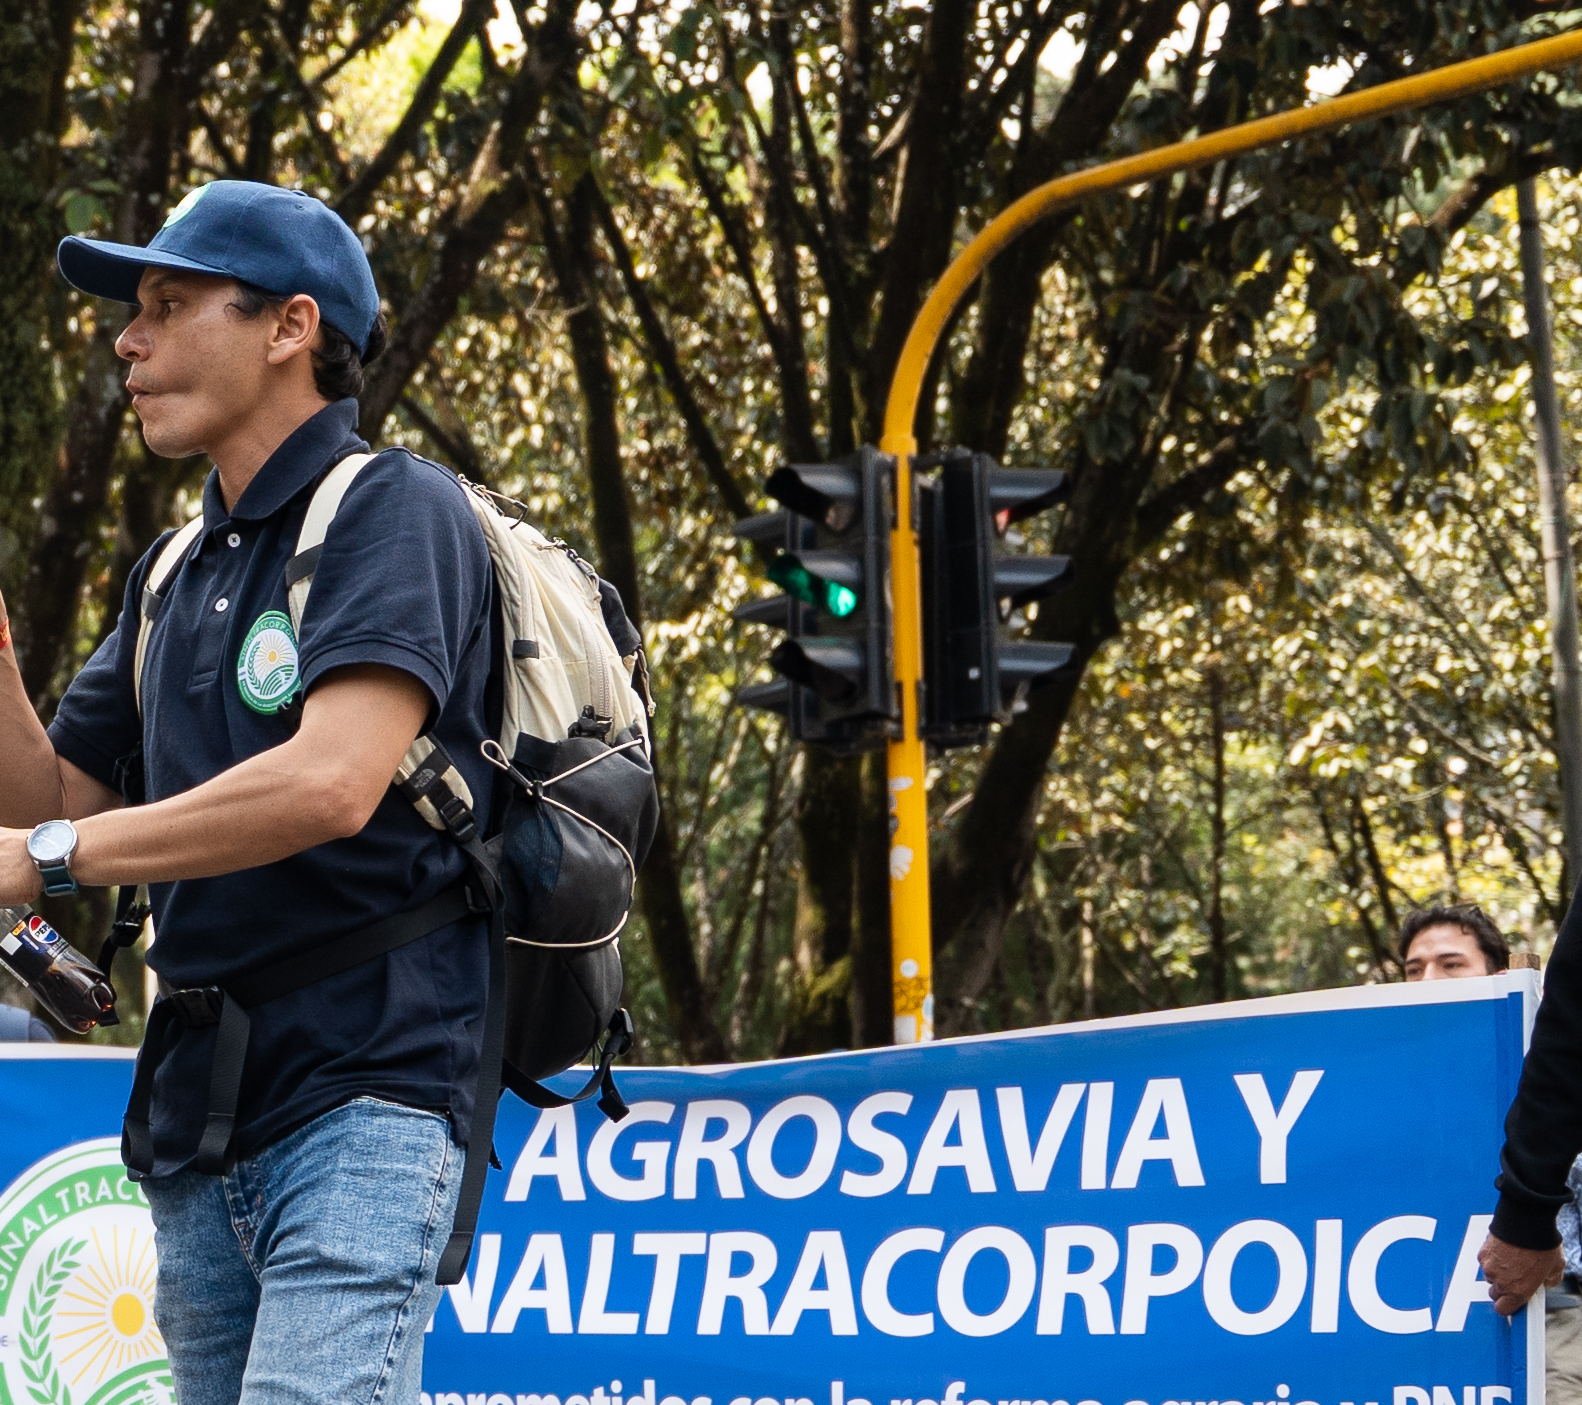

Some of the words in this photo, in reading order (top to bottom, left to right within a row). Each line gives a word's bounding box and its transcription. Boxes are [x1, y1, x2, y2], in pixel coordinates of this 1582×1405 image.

[504, 1078, 1205, 1202] AGROSAVIA
[1233, 1070, 1324, 1185] Y
[425, 1215, 1503, 1337] NALTRACORPOICA
